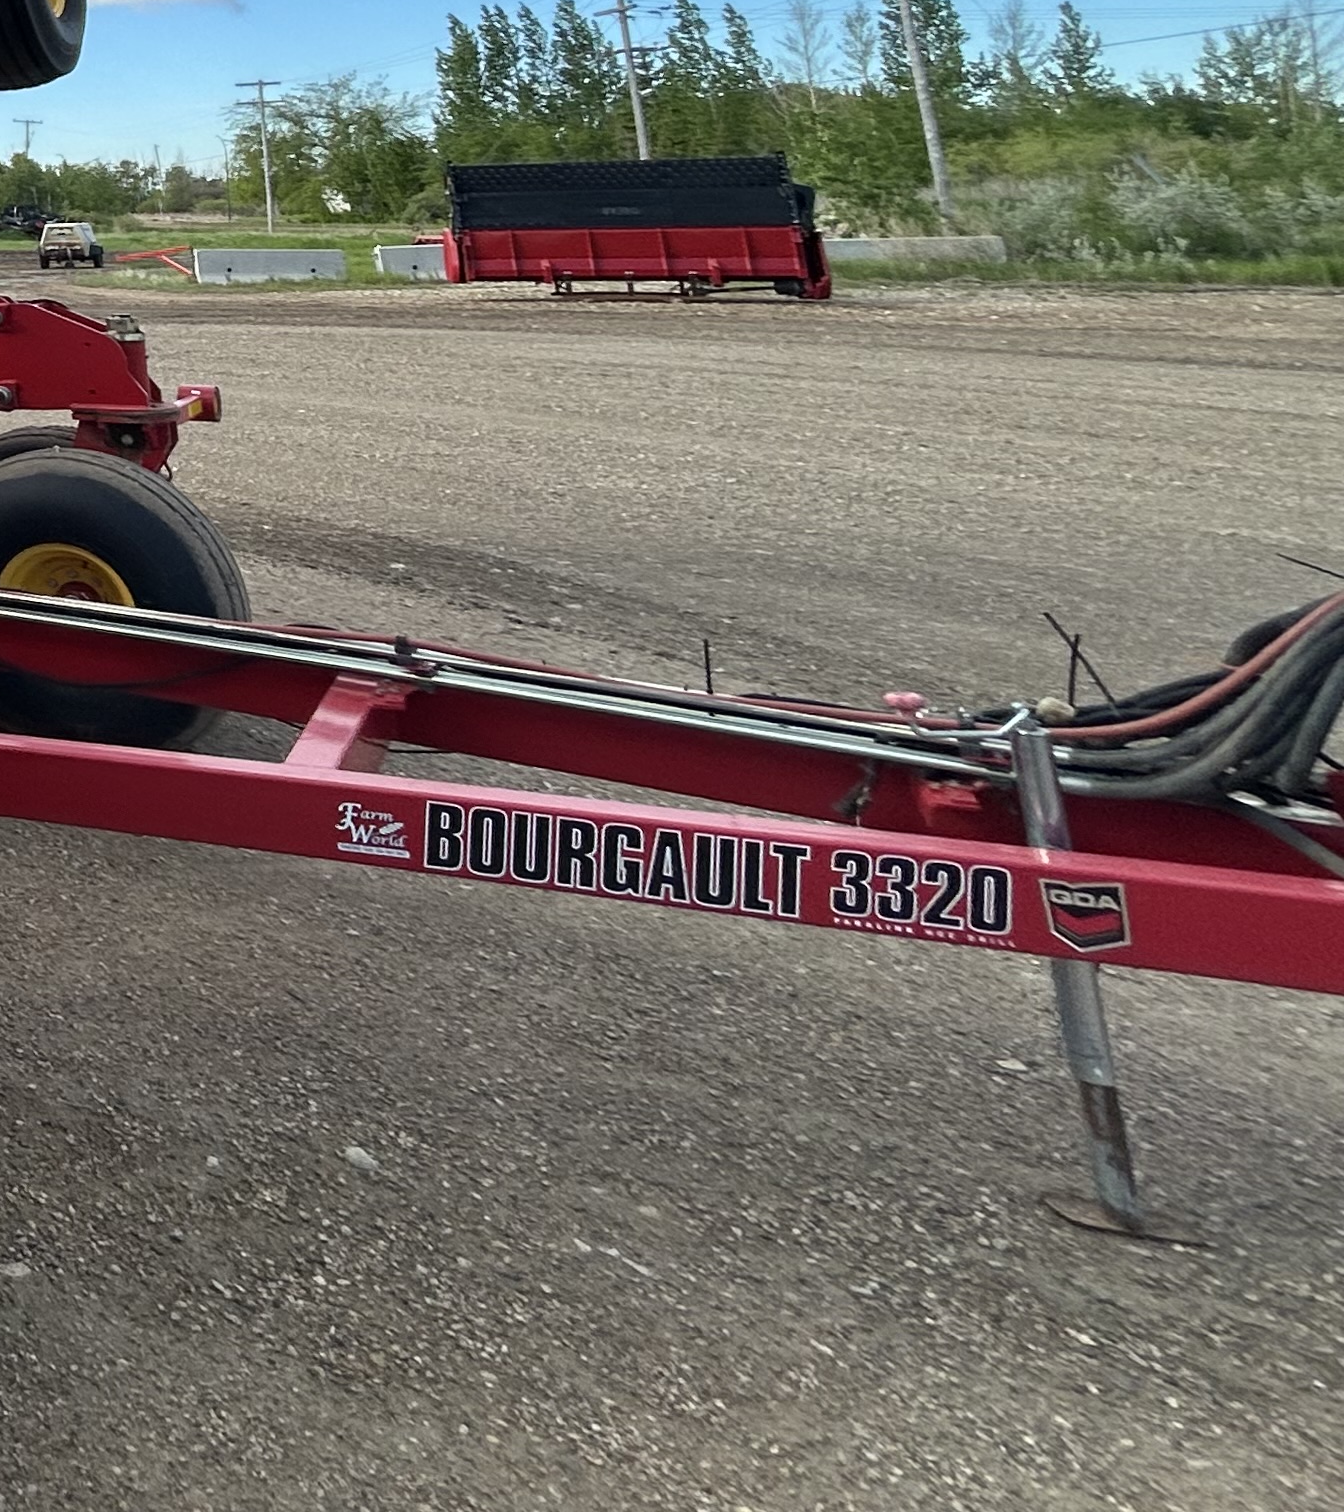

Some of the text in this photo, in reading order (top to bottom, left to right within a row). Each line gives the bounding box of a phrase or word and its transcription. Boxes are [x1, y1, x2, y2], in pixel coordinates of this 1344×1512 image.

[334, 801, 394, 830] Farm
[349, 822, 408, 847] World
[423, 799, 1013, 935] BOURGAULT 3320
